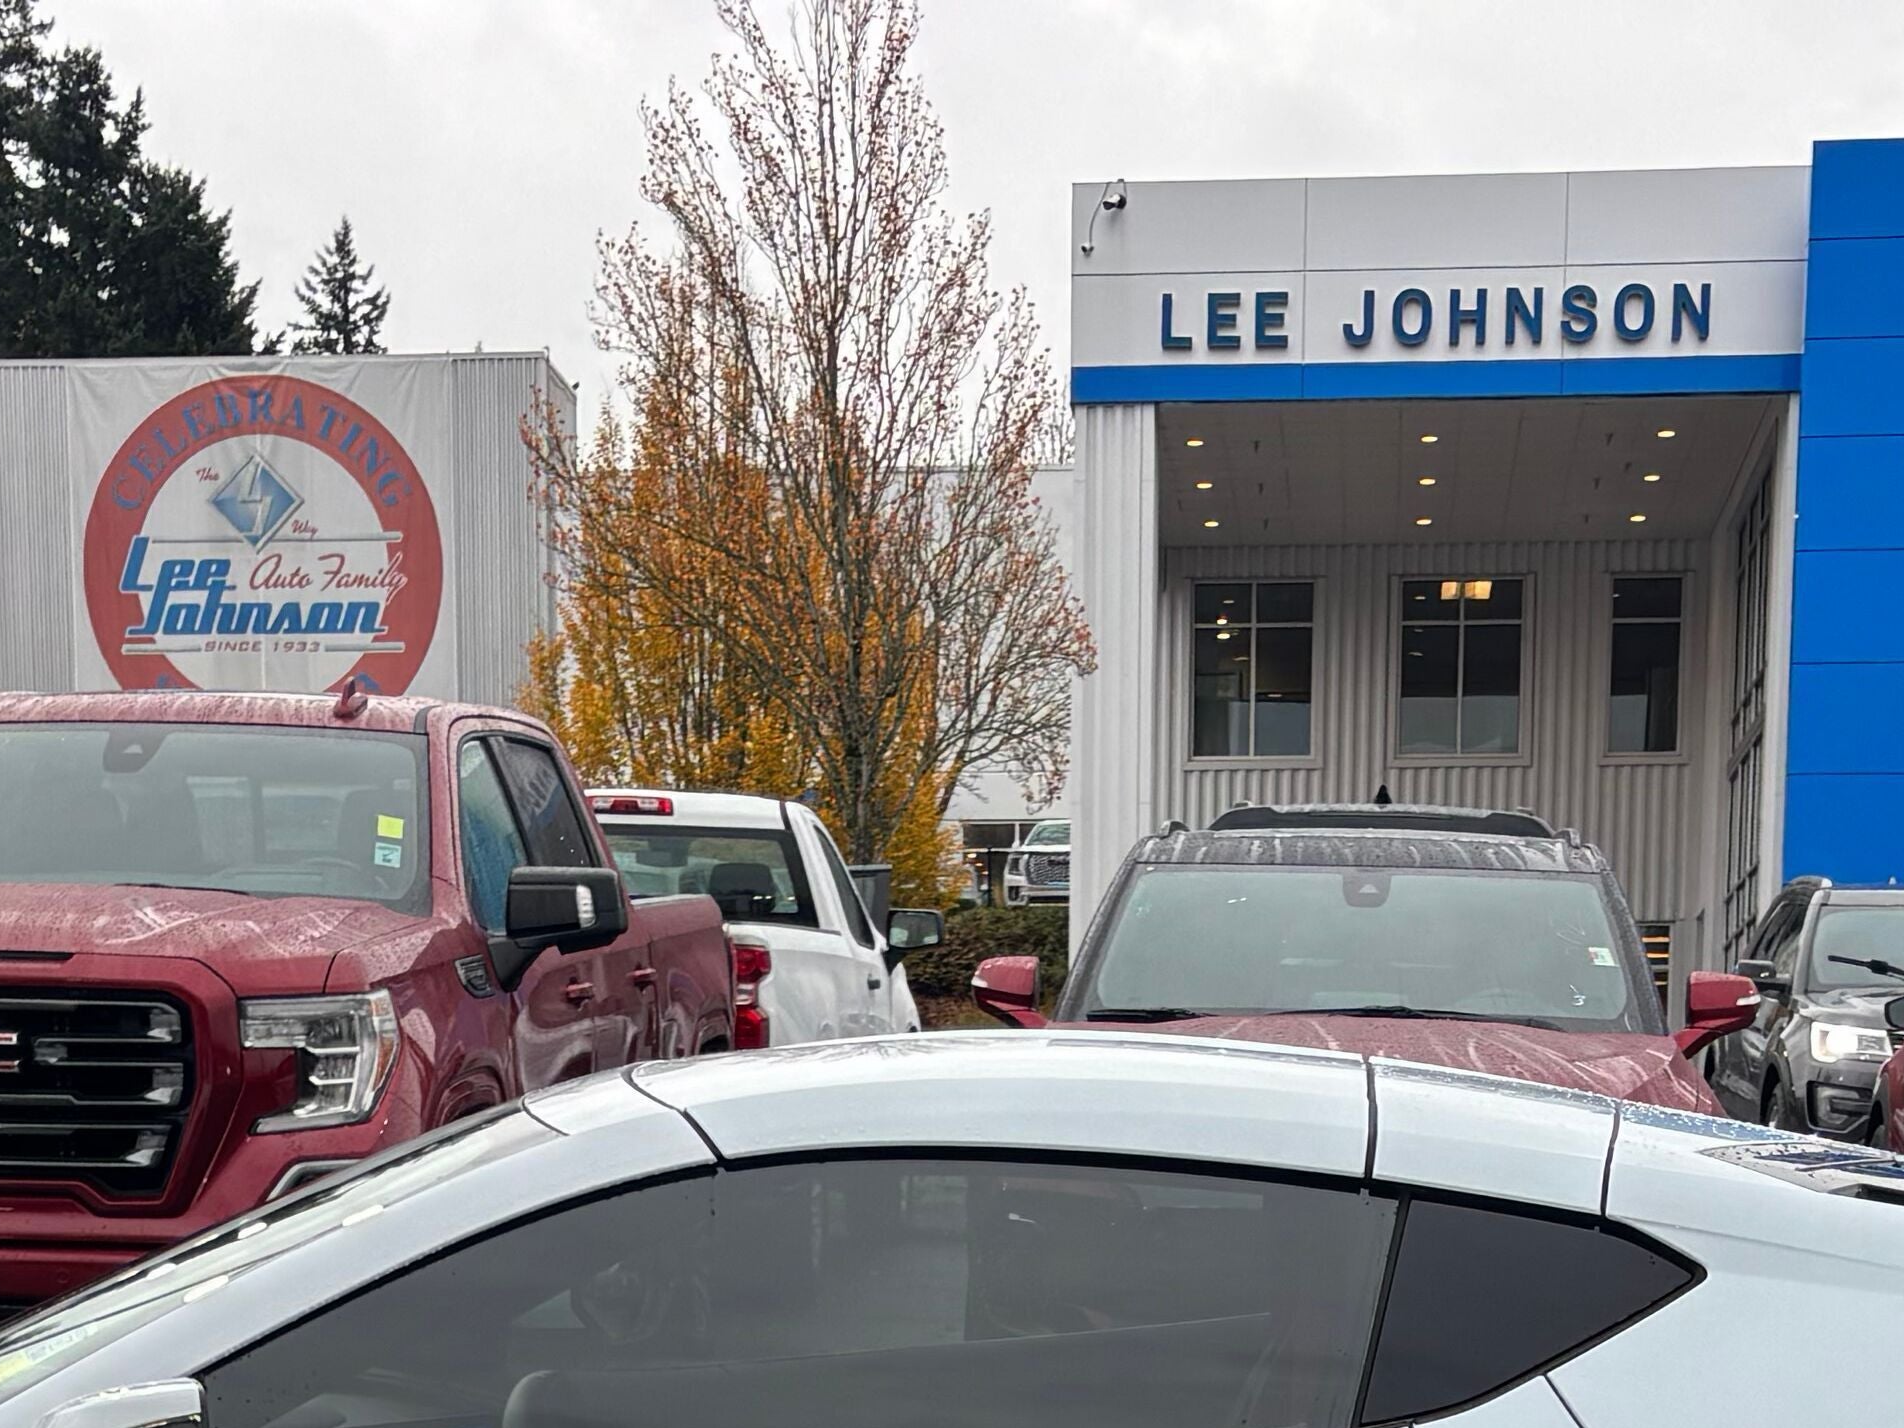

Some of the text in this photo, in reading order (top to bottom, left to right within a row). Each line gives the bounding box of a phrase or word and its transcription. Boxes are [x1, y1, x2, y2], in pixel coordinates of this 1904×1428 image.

[1160, 282, 1713, 350] LEE JOHNSON
[111, 386, 412, 511] CELEBRATING
[195, 467, 220, 483] The
[120, 536, 408, 604] Lee Auto Family
[126, 588, 388, 637] Johnson
[203, 640, 321, 653] SINCE 1933
